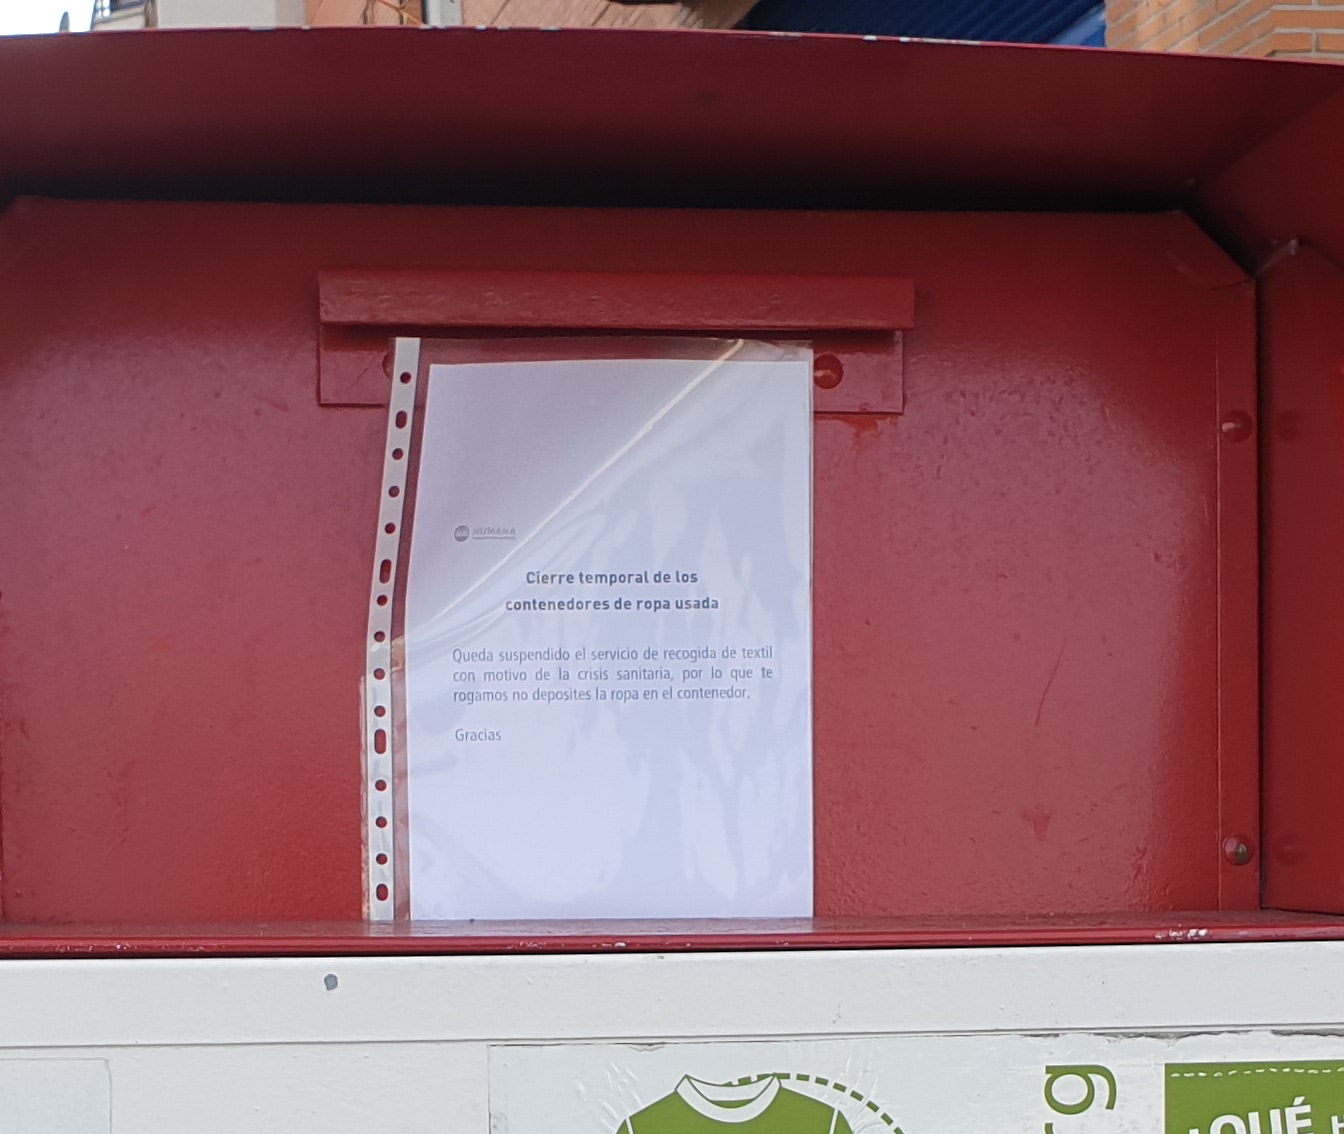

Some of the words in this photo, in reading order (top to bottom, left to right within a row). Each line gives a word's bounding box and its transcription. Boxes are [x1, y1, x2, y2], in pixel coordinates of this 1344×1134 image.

[526, 571, 575, 584] Cierre
[579, 571, 649, 586] temporal
[653, 571, 671, 583] de
[676, 570, 698, 583] los
[506, 598, 610, 610] contenedores
[614, 597, 632, 609] de
[637, 600, 671, 612] ropa
[675, 597, 719, 609] usada
[452, 648, 494, 664] Queda
[498, 648, 570, 664] suspendido
[575, 648, 586, 660] el
[590, 647, 639, 660] servicio
[643, 647, 659, 660] de
[663, 646, 717, 663] recogida
[721, 646, 737, 659] de
[742, 645, 773, 659] textil
[453, 671, 475, 682] con
[484, 668, 527, 682] motivo
[535, 667, 551, 681] de
[558, 667, 570, 680] la
[578, 667, 609, 680] crisis
[616, 666, 674, 681] sanitaria,
[682, 669, 703, 683] por
[711, 666, 723, 679] lo
[730, 669, 753, 682] que
[761, 667, 773, 679] te
[453, 691, 508, 705] rogamos
[512, 691, 529, 701] no
[532, 687, 592, 703] deposites
[595, 687, 607, 700] la
[611, 689, 639, 704] ropa
[643, 689, 658, 700] en
[662, 686, 673, 700] el
[677, 686, 750, 699] contenedor.
[455, 728, 502, 741] Gracias
